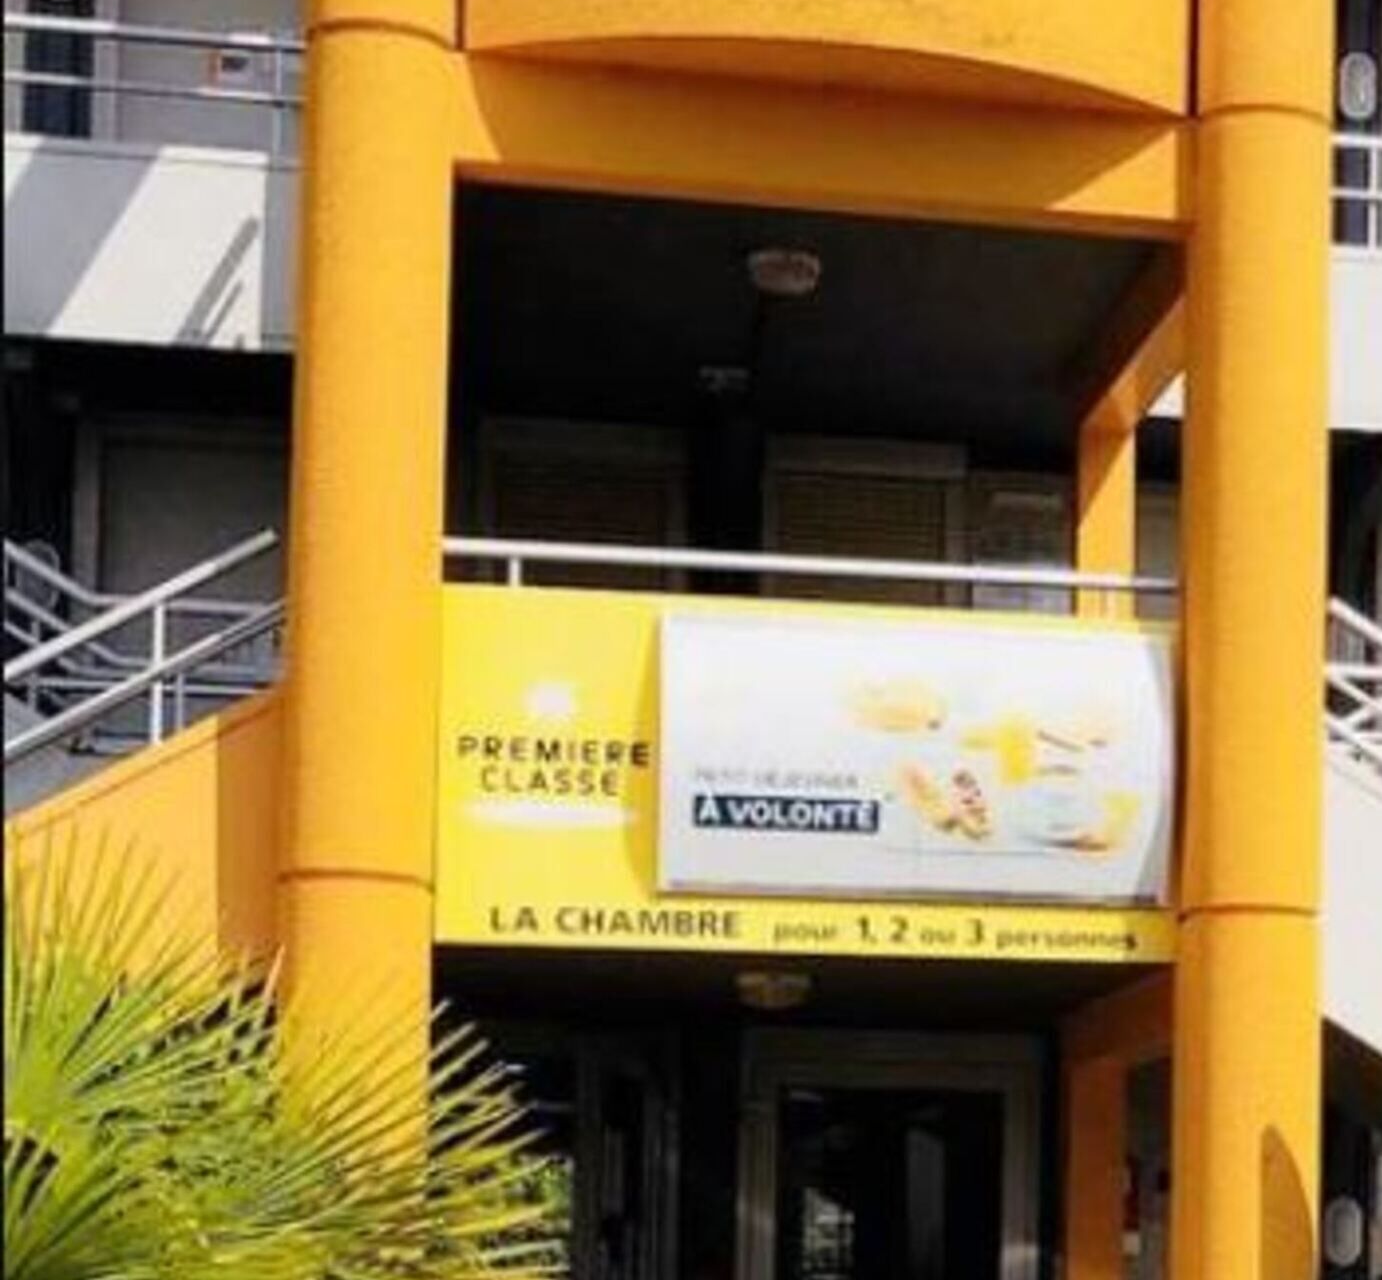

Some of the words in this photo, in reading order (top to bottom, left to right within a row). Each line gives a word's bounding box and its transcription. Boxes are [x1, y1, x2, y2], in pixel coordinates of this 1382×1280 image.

[457, 734, 651, 768] PREMIERE
[479, 770, 621, 797] CLASSE
[726, 797, 874, 829] VOLONTÉ
[490, 906, 539, 934] LA
[554, 907, 742, 939] CHAMBRE
[773, 922, 840, 948] pour
[889, 916, 909, 943] 2
[920, 926, 957, 946] ou
[965, 918, 984, 946] 3
